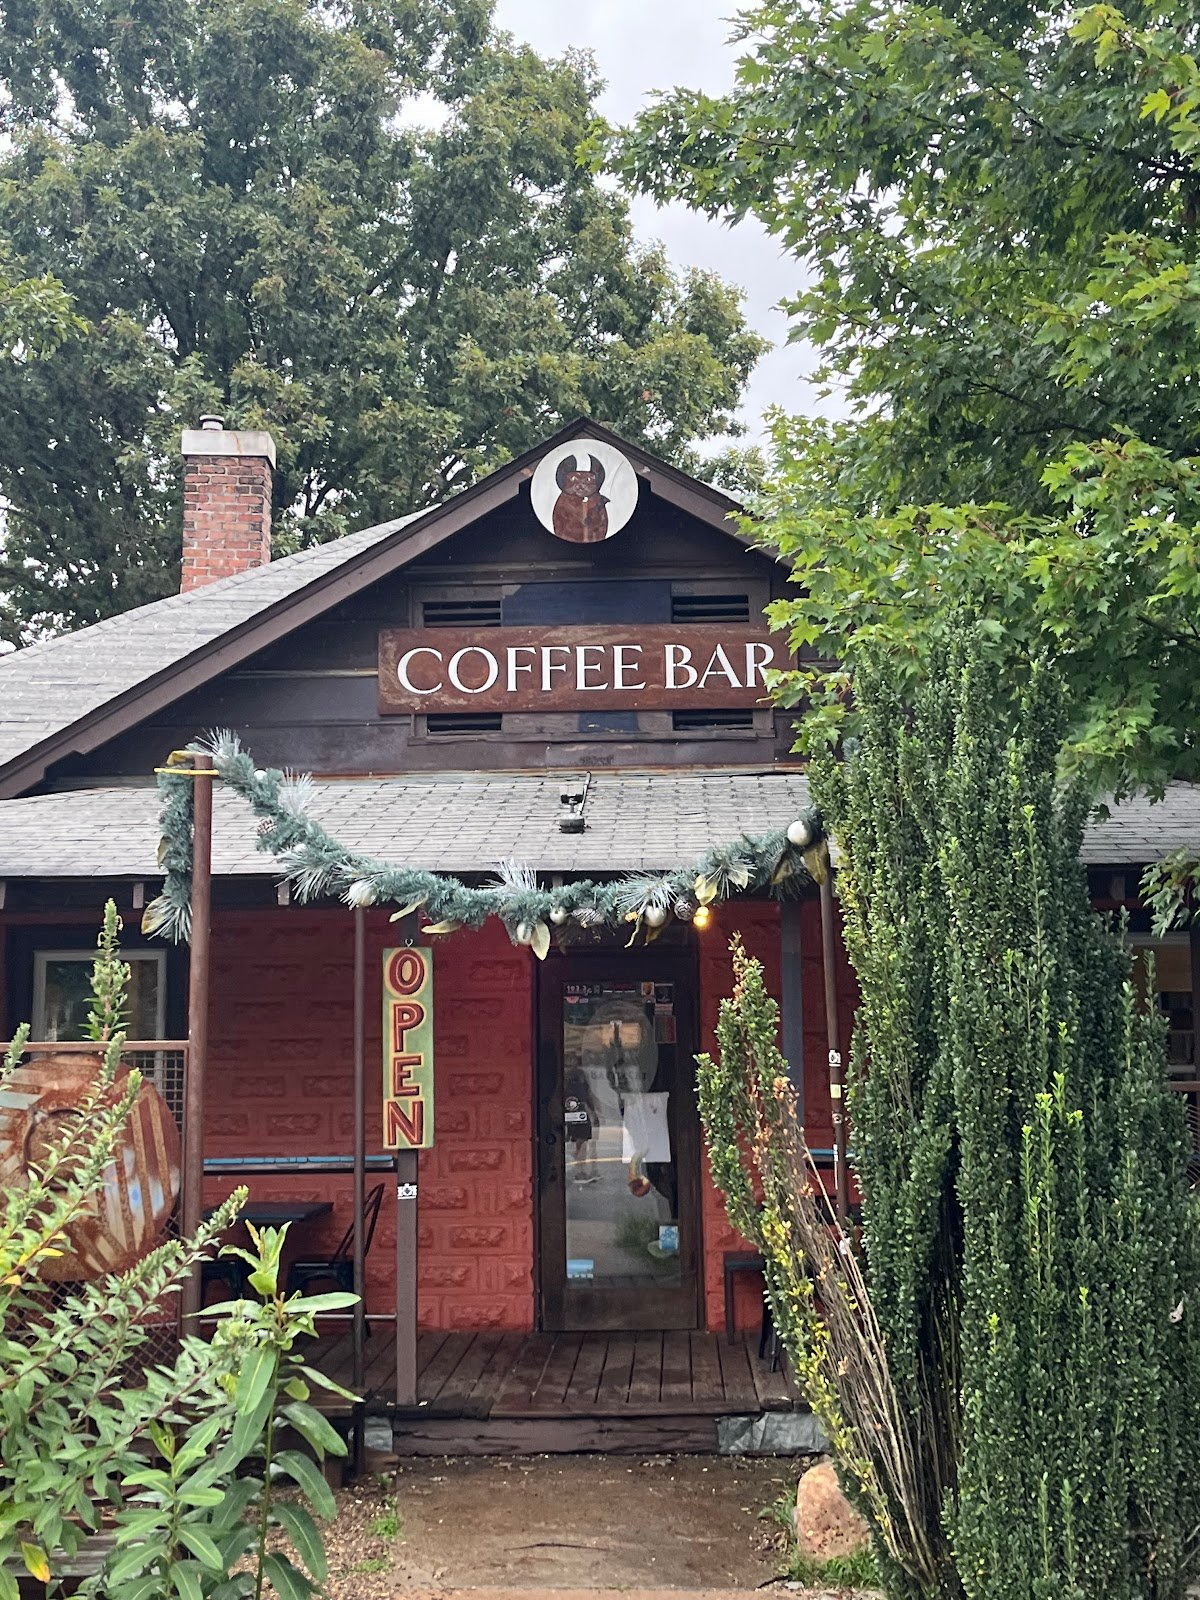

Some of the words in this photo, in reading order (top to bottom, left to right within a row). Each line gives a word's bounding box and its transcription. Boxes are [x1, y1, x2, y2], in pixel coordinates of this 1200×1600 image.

[397, 646, 646, 694] COFFEE
[664, 643, 778, 688] BAR
[387, 948, 425, 1146] OPEN
